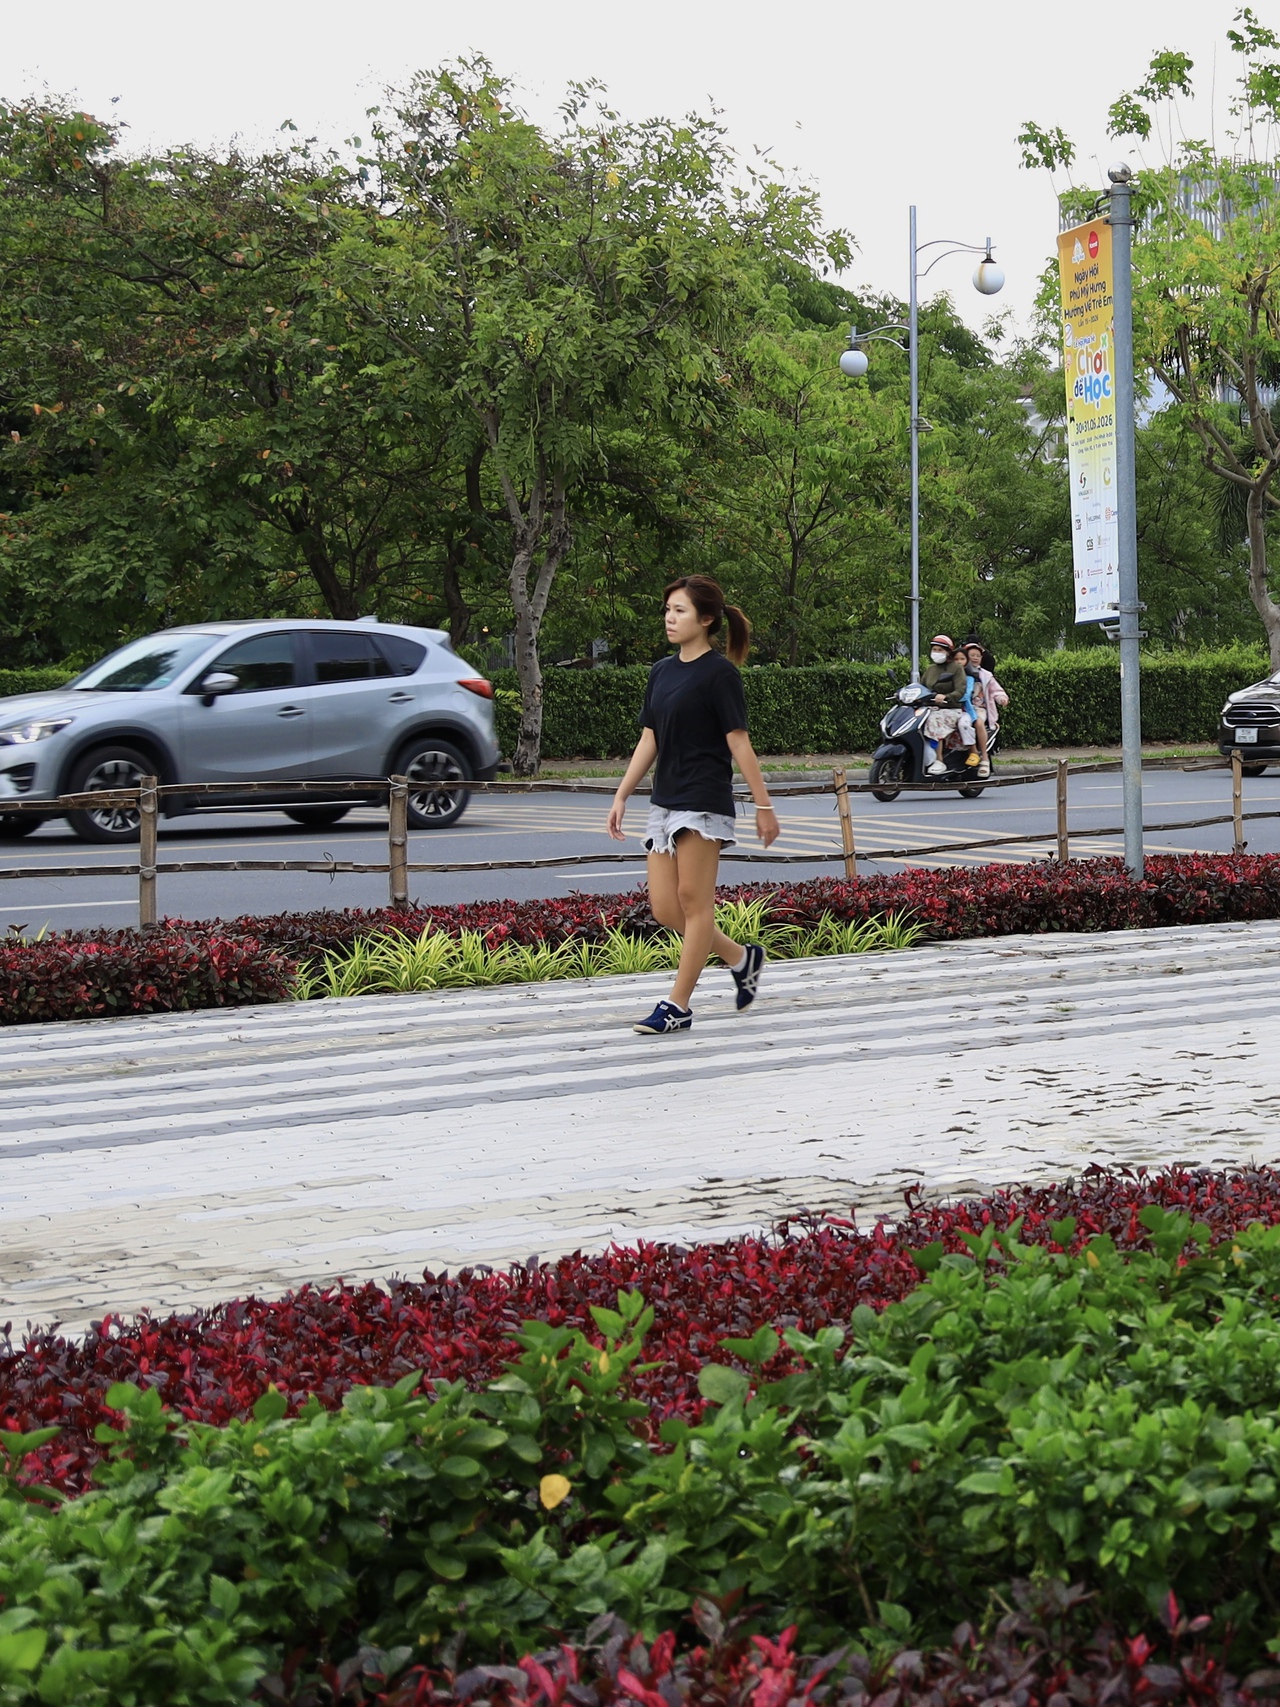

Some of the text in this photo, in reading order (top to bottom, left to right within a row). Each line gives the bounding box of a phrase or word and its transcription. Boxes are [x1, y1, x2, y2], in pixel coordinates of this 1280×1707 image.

[1074, 263, 1099, 284] Ngày Hội
[1070, 281, 1106, 301] Phú Mỹ Hưng
[1103, 295, 1114, 307] Em
